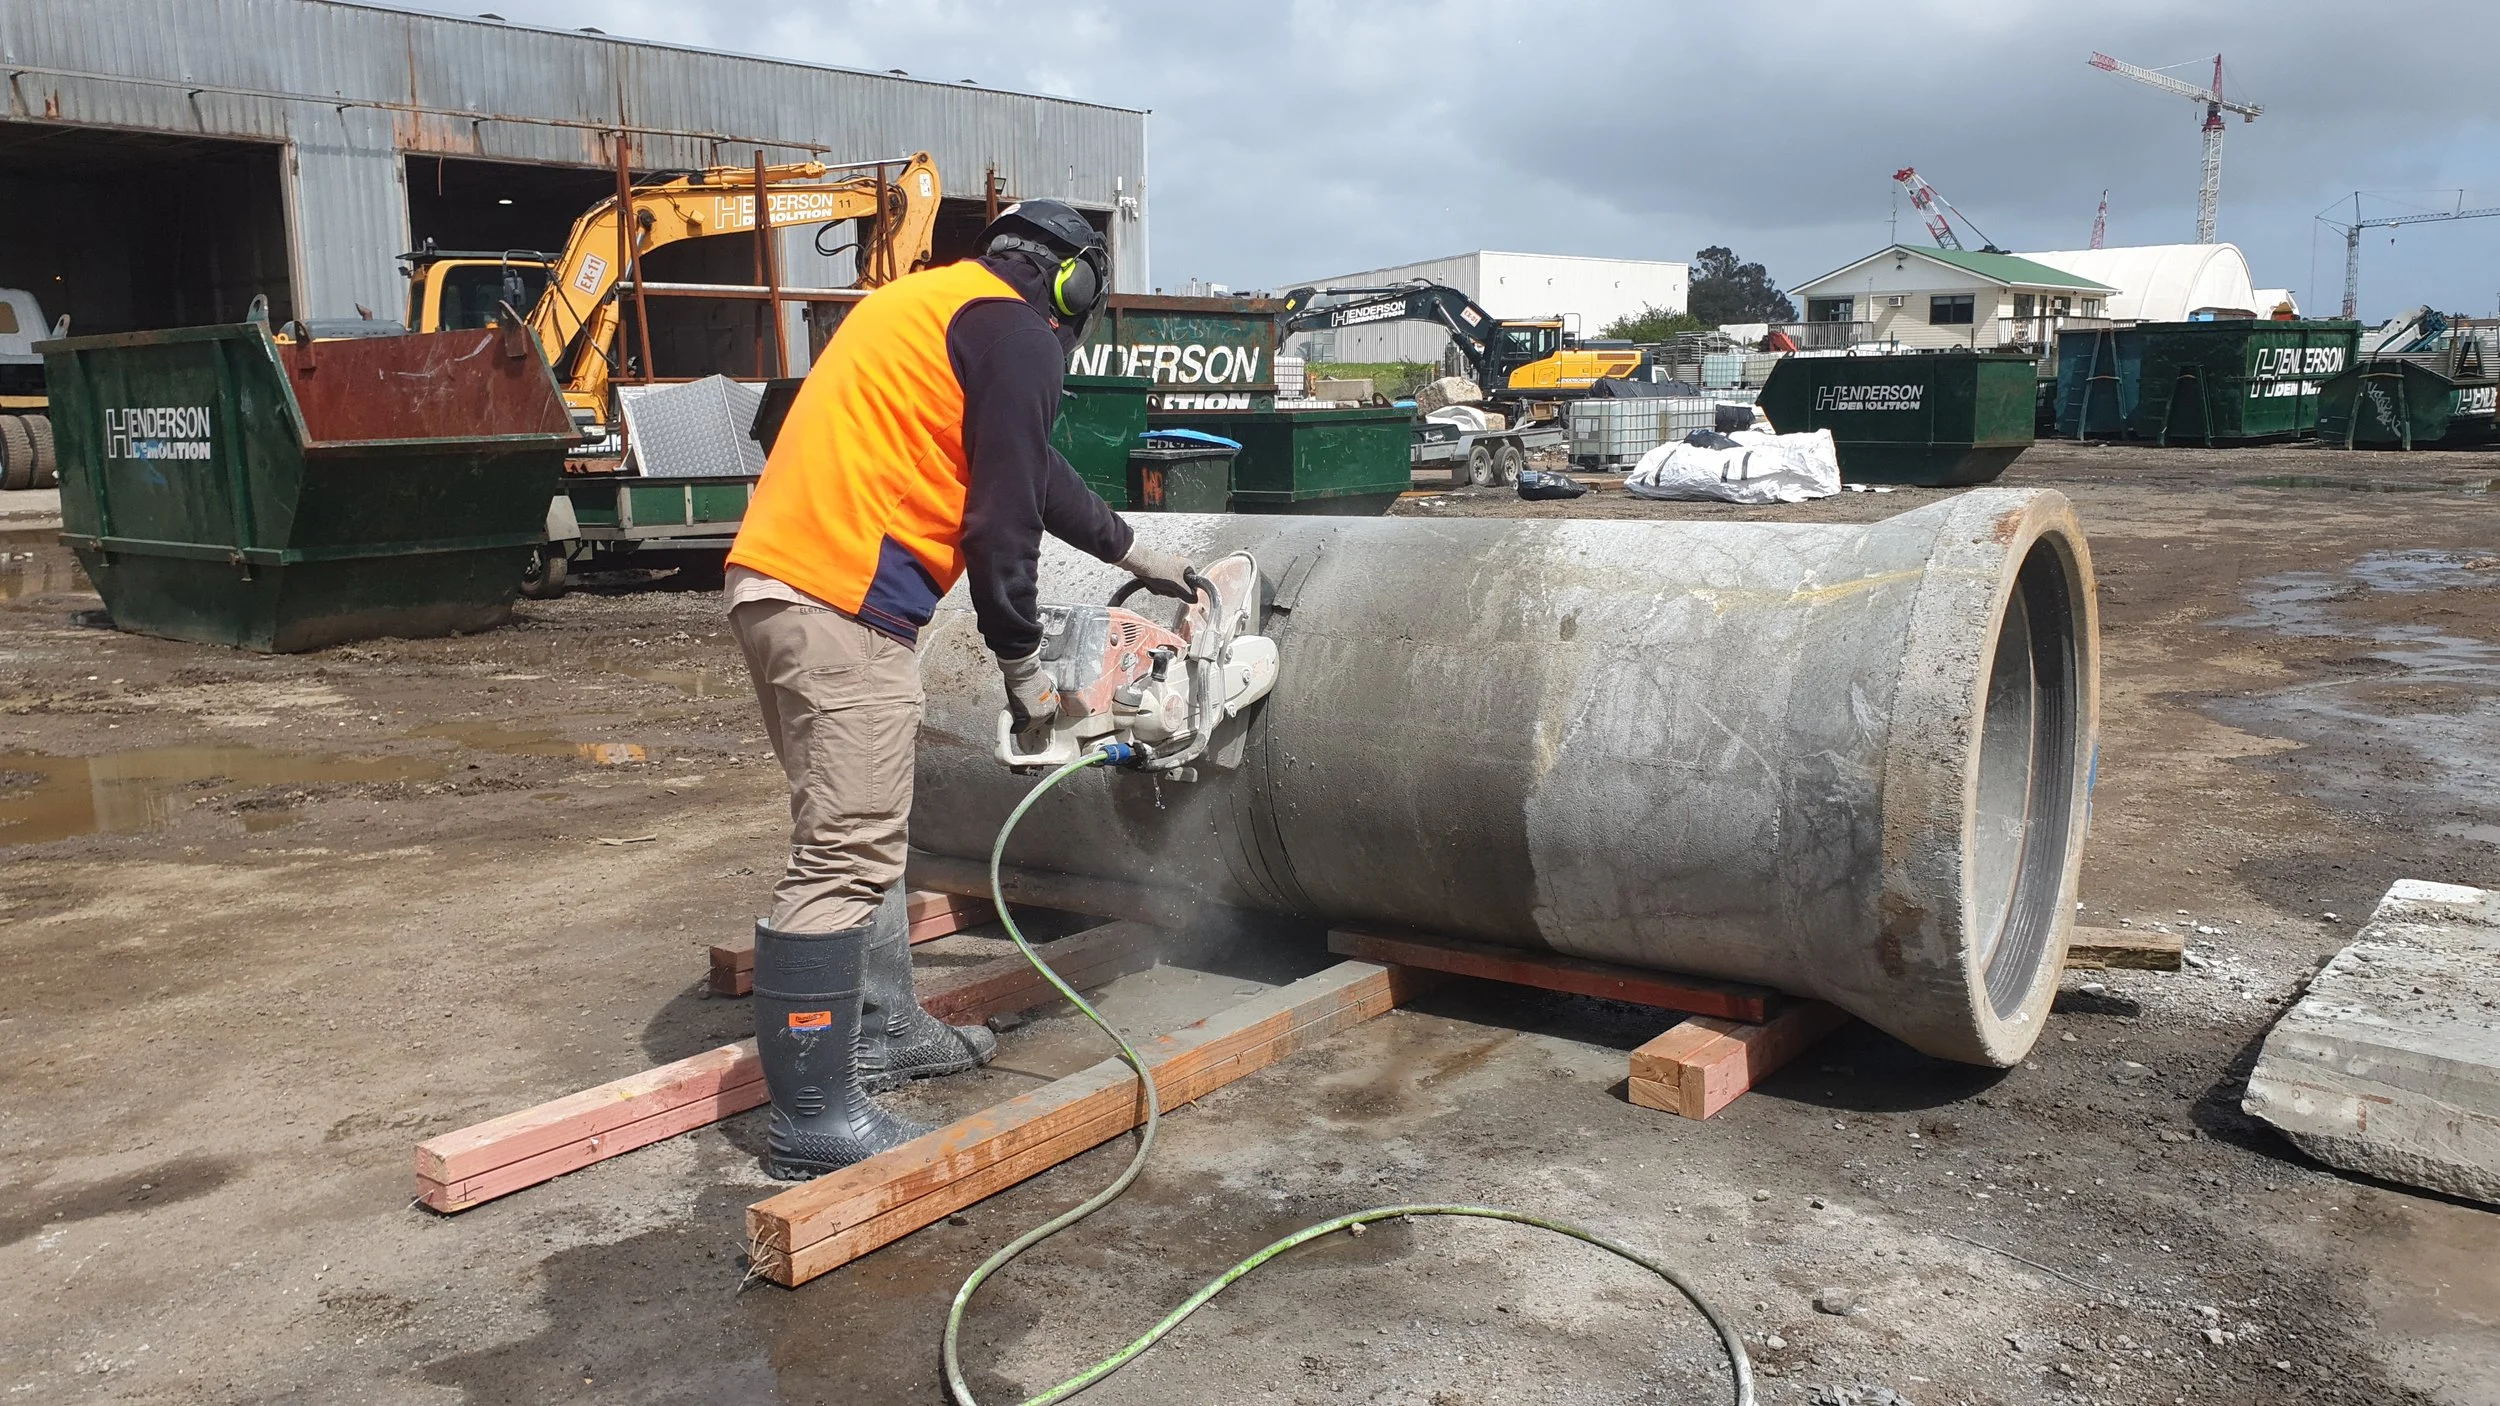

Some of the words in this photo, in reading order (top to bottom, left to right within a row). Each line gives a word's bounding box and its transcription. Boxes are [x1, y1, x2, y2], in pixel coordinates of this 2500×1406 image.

[715, 193, 833, 229] HEDERSON
[743, 209, 832, 226] DOLITION
[580, 258, 601, 289] EX-11
[1331, 300, 1406, 327] HENDERSON
[1348, 310, 1406, 325] DEMOLITION
[1815, 385, 1924, 410] HENDERSON
[1838, 401, 1920, 410] DEMOLITION
[106, 406, 211, 459] HENDERSON
[132, 441, 211, 460] DEMOLITION
